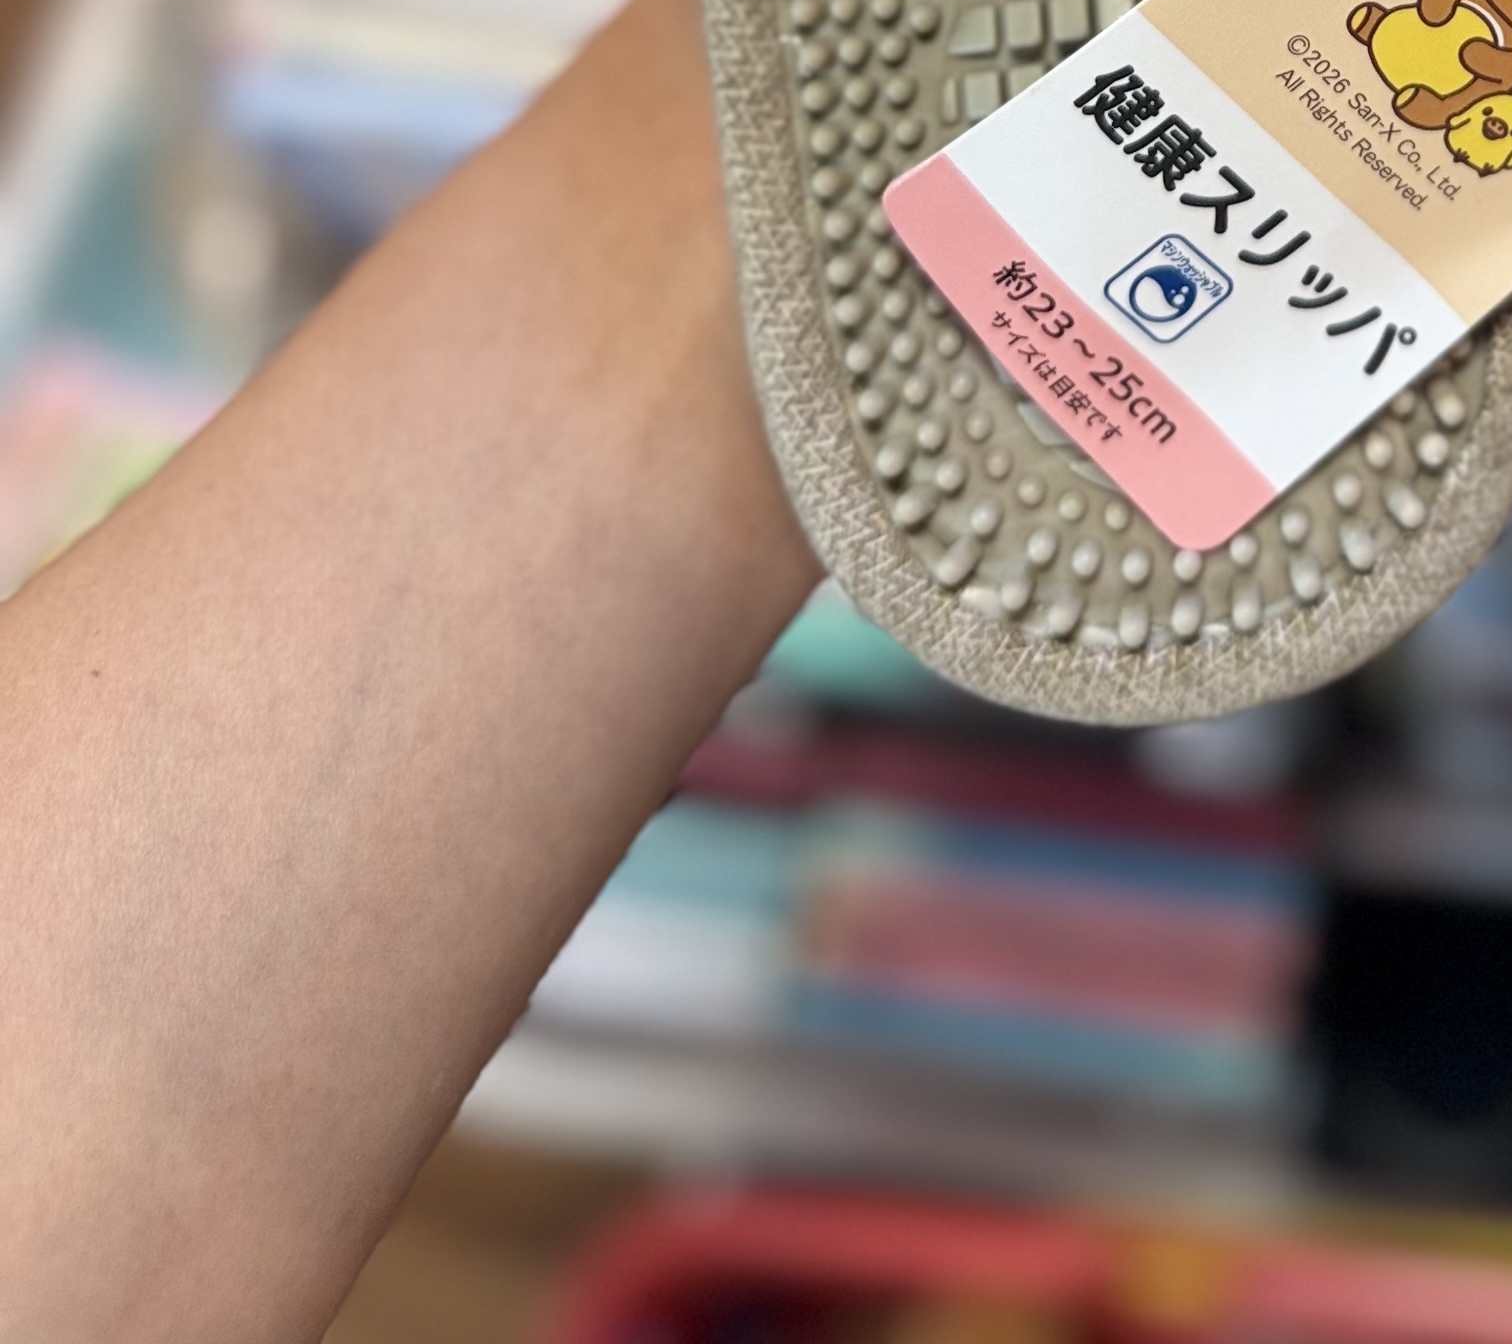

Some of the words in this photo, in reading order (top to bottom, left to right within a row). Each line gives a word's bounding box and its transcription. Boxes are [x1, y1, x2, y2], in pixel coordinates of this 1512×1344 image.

[1275, 69, 1305, 93] All
[1298, 87, 1354, 142] Rights
[1351, 137, 1429, 211] Reserved.
[1287, 34, 1351, 94] ©2026
[1347, 92, 1402, 143] San-X
[1396, 139, 1423, 172] Co.,
[1425, 165, 1462, 201] Ltd.
[1073, 64, 1418, 376] 健康スリッパ
[991, 309, 1124, 442] サイズは目安です
